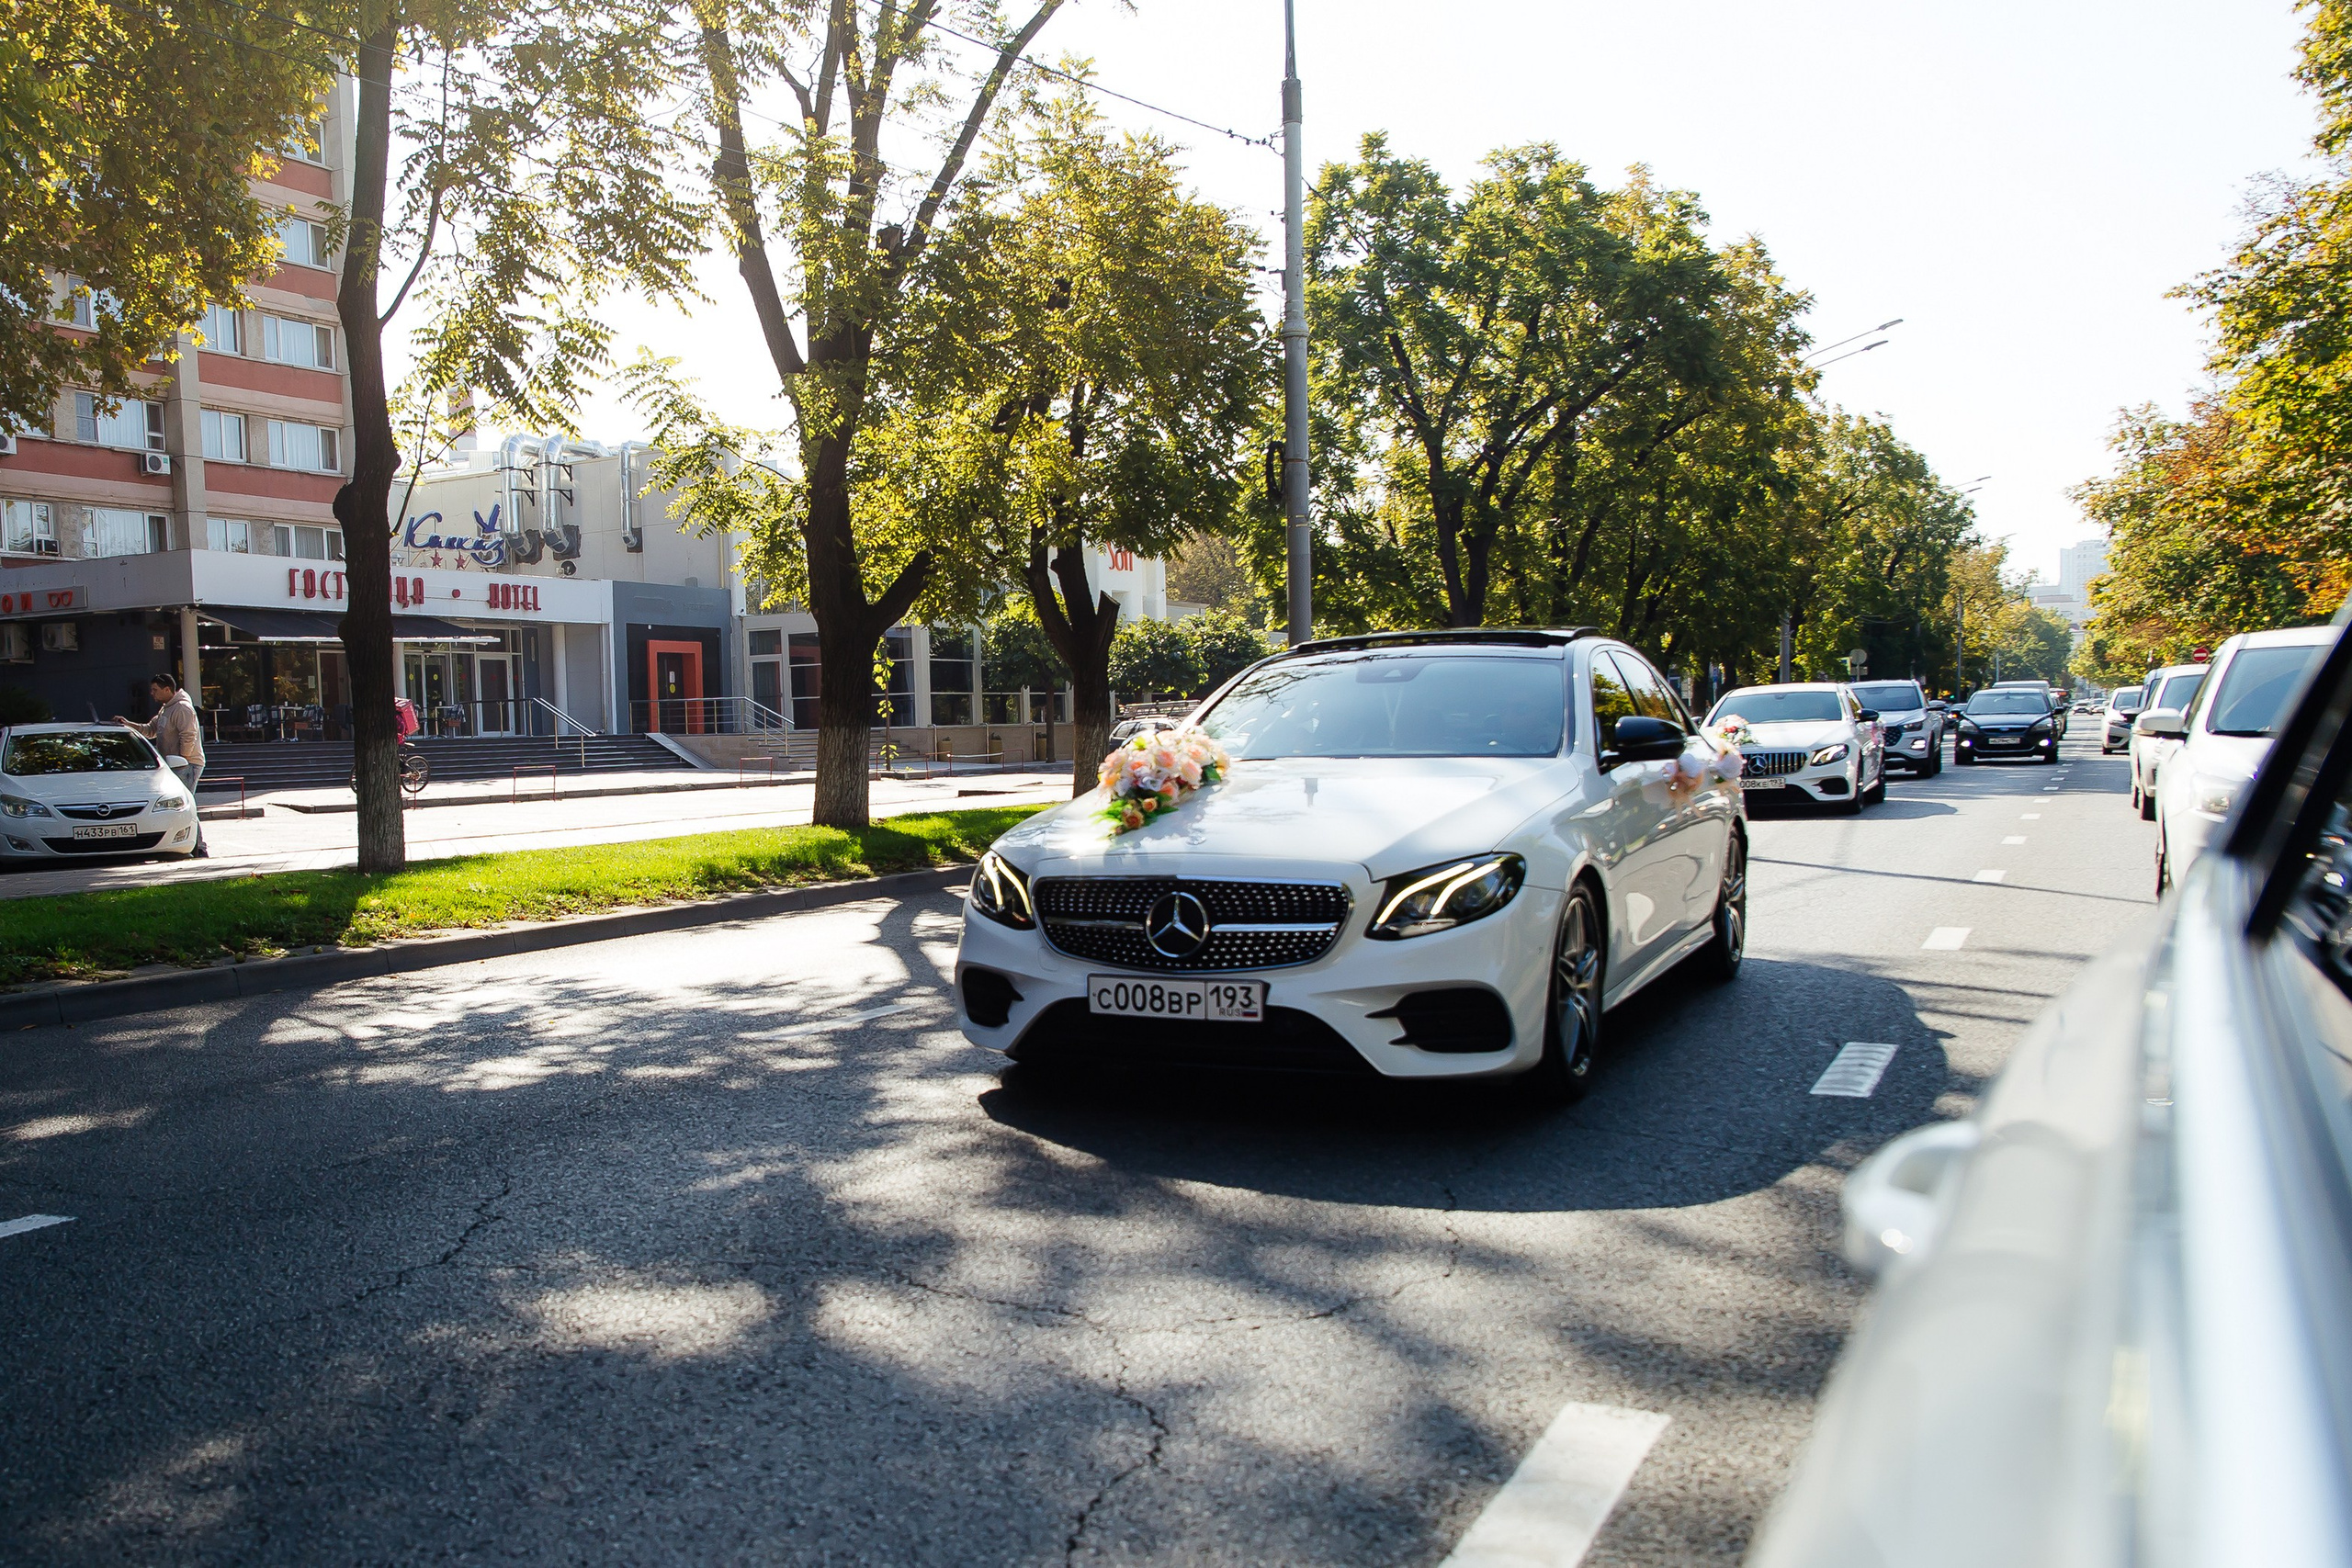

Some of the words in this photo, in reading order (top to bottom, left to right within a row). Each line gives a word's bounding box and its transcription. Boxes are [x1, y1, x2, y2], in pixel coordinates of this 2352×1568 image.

[288, 568, 424, 608] ГОСТЦА
[488, 582, 541, 611] HOTEL
[1209, 986, 1253, 1009] 193
[1219, 1008, 1241, 1017] RUS
